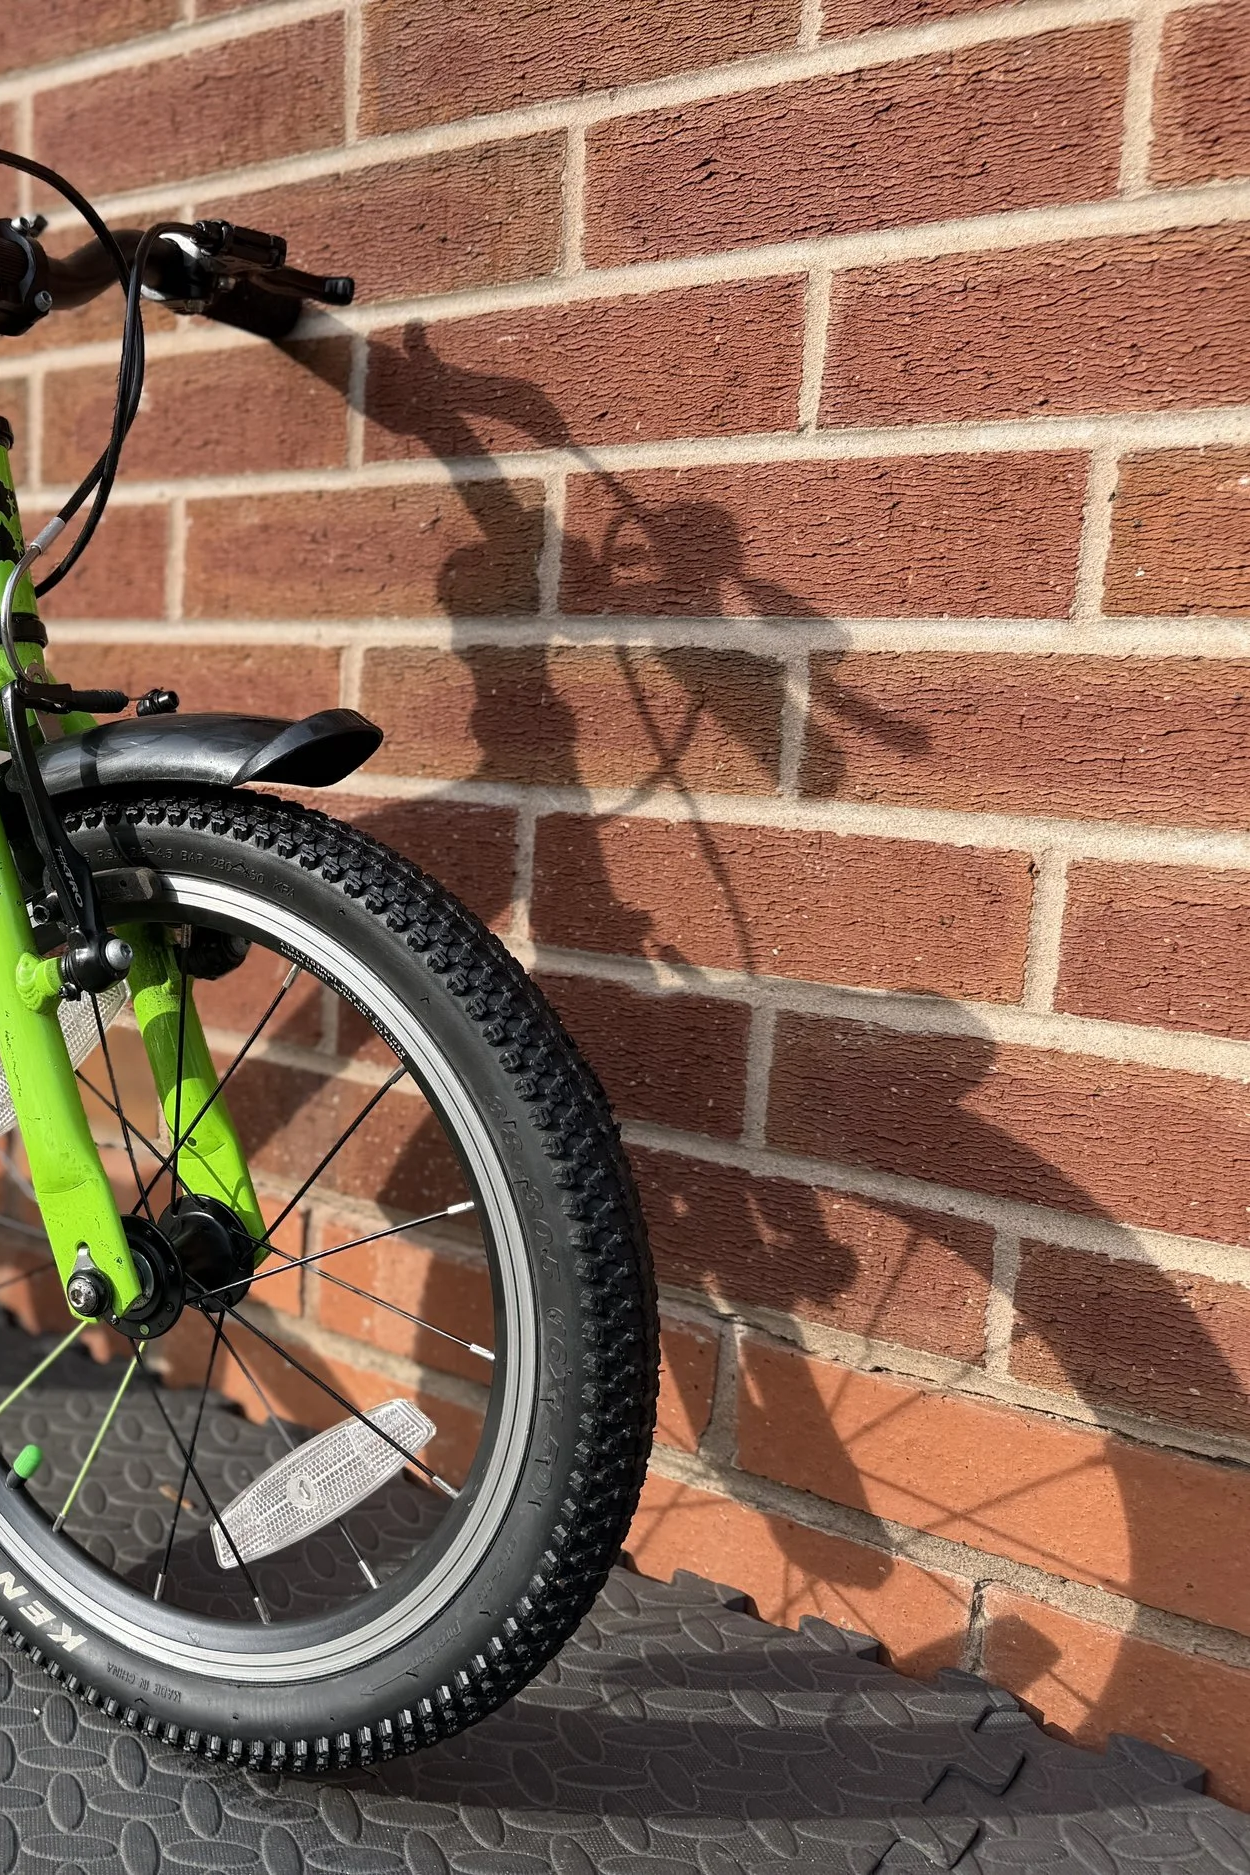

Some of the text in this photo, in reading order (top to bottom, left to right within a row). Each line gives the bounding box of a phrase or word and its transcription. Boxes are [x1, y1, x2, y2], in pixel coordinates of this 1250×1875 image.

[54, 845, 84, 909] TEKTRO
[180, 850, 204, 866] BAR
[272, 880, 297, 899] KPA
[280, 947, 304, 963] WORN
[313, 968, 328, 981] LINE
[279, 941, 406, 1057] REPLACE THE RIM IMMEDIATELY
[371, 1020, 383, 1035] THE
[383, 1035, 403, 1060] WHEN
[106, 1660, 182, 1703] MADE IN CHINA
